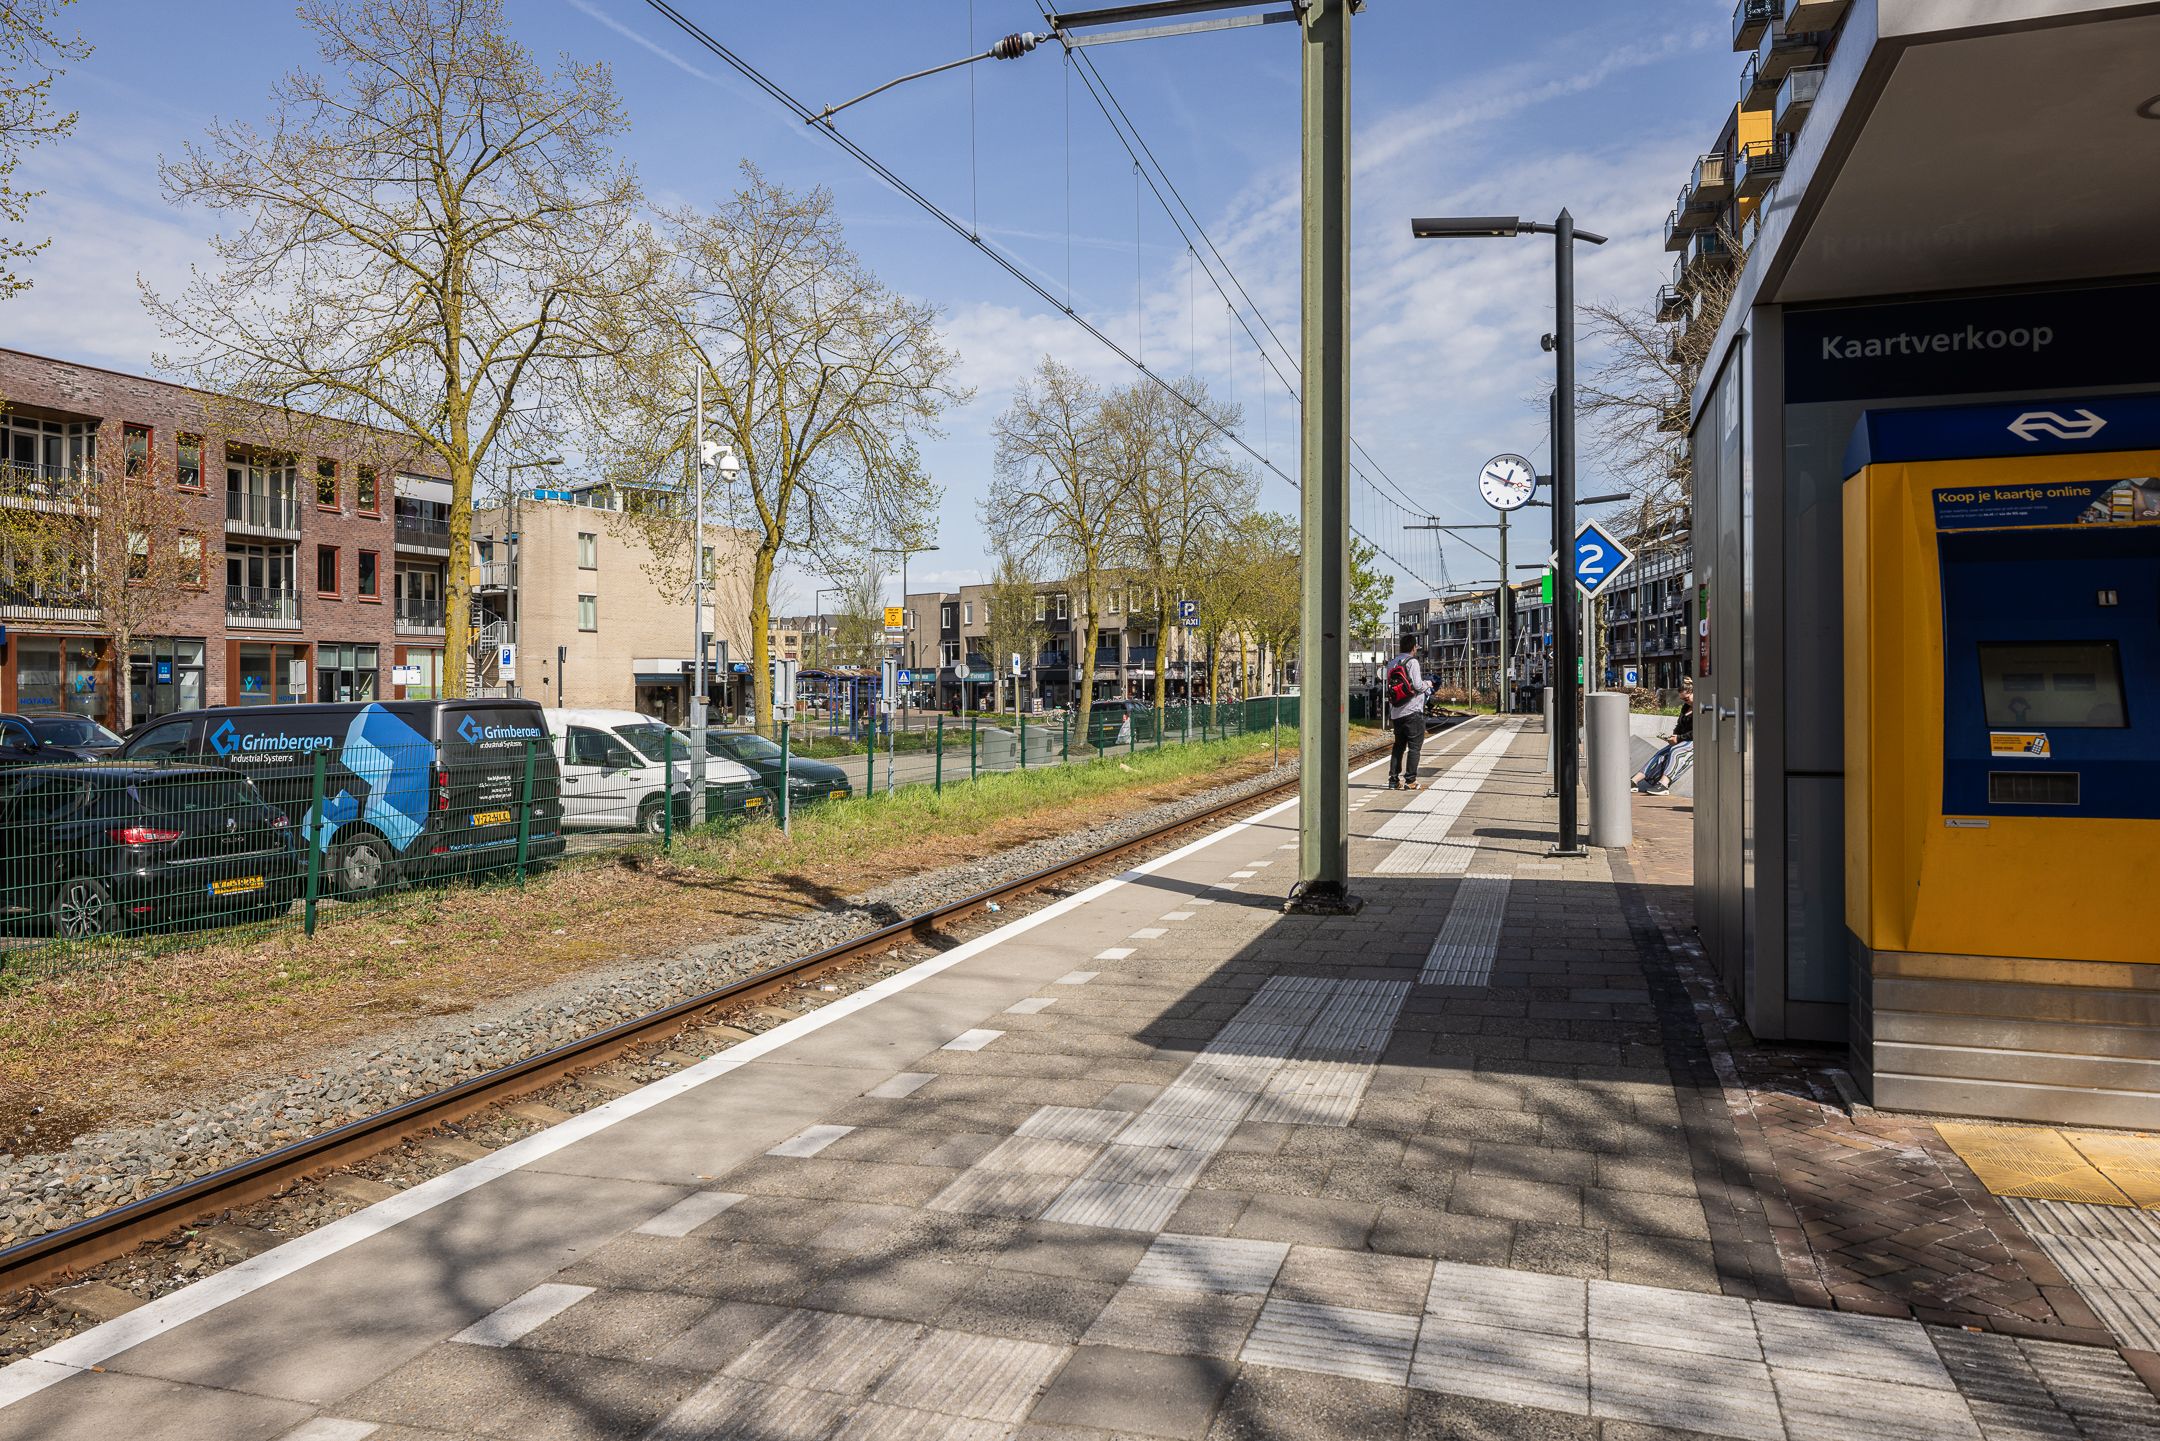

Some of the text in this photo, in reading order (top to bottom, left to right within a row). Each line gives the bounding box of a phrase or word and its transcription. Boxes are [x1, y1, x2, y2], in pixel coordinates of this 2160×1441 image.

[1822, 324, 2054, 360] Kaartverkoop
[1938, 485, 2092, 505] Koop je kaartje online
[1578, 543, 1604, 574] 2
[1184, 602, 1195, 616] P
[1182, 618, 1199, 626] TAXI
[242, 732, 333, 755] Grimbergen
[231, 753, 293, 765] Industrial Systems
